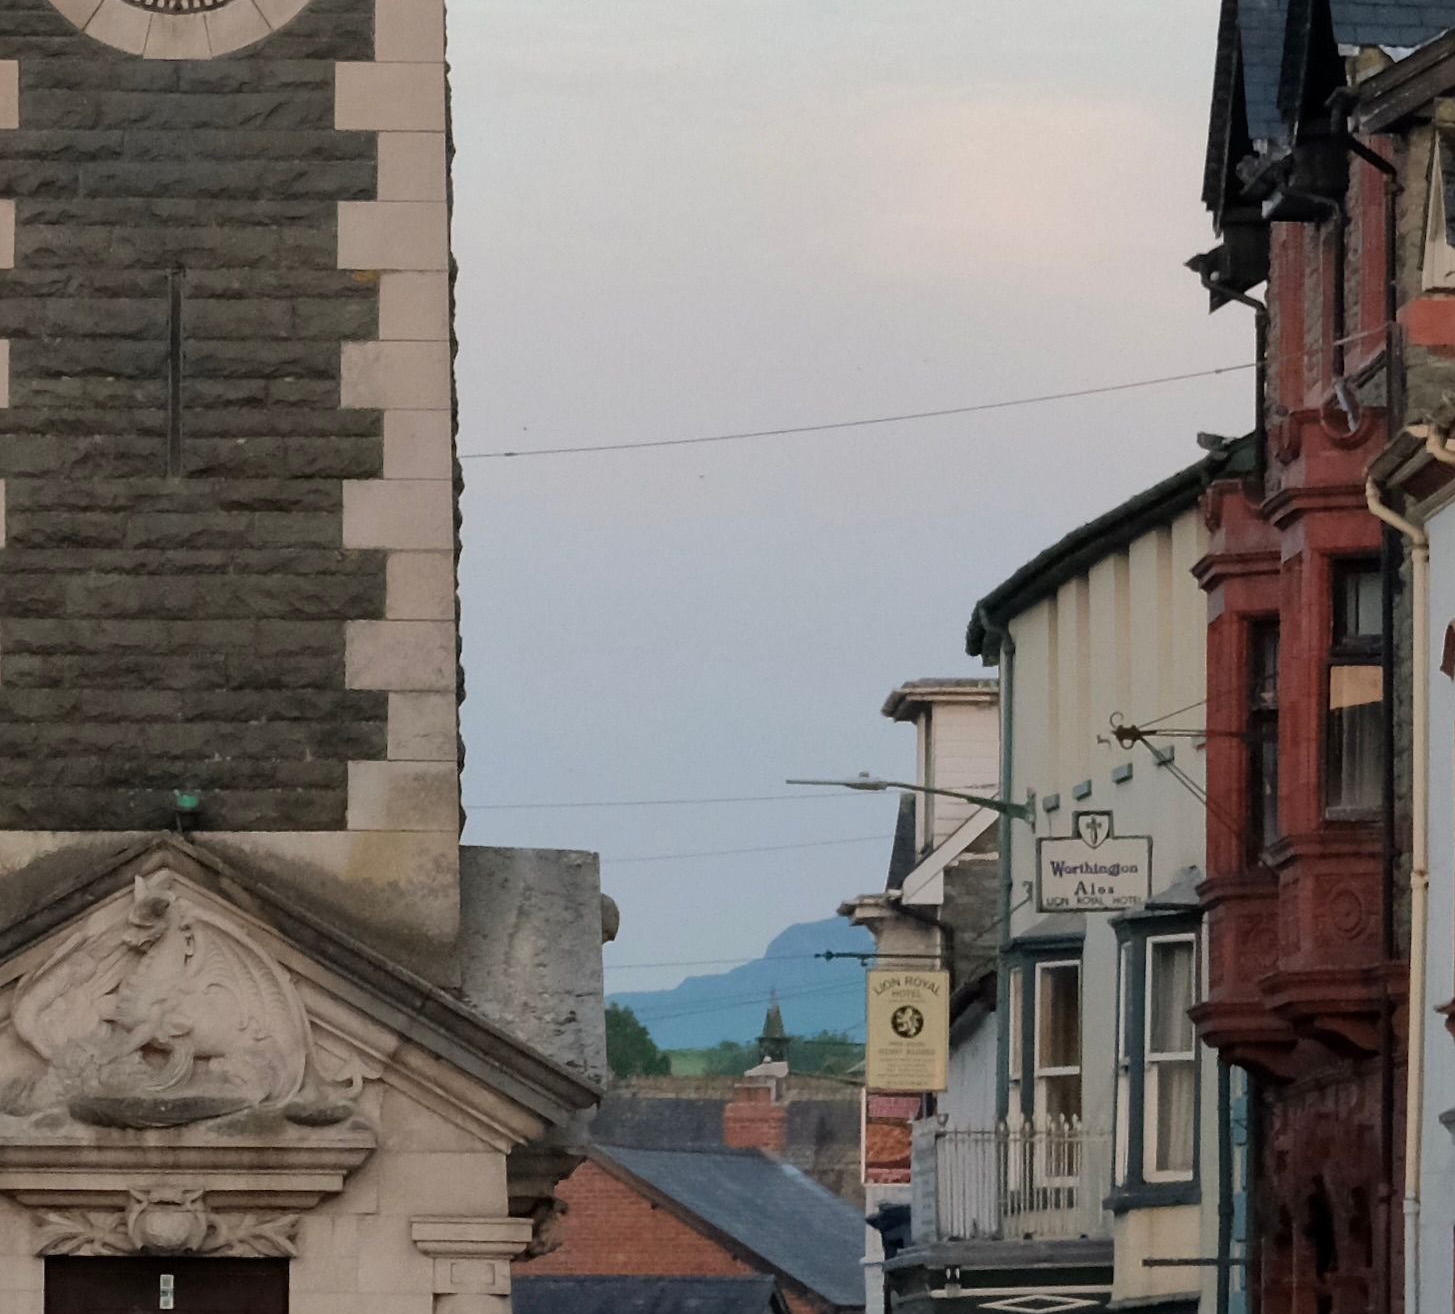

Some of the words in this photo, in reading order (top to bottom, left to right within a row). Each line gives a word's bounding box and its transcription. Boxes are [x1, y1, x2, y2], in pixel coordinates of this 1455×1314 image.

[873, 977, 901, 996] LION
[905, 976, 940, 996] ROYAL
[891, 989, 922, 998] HOTEL
